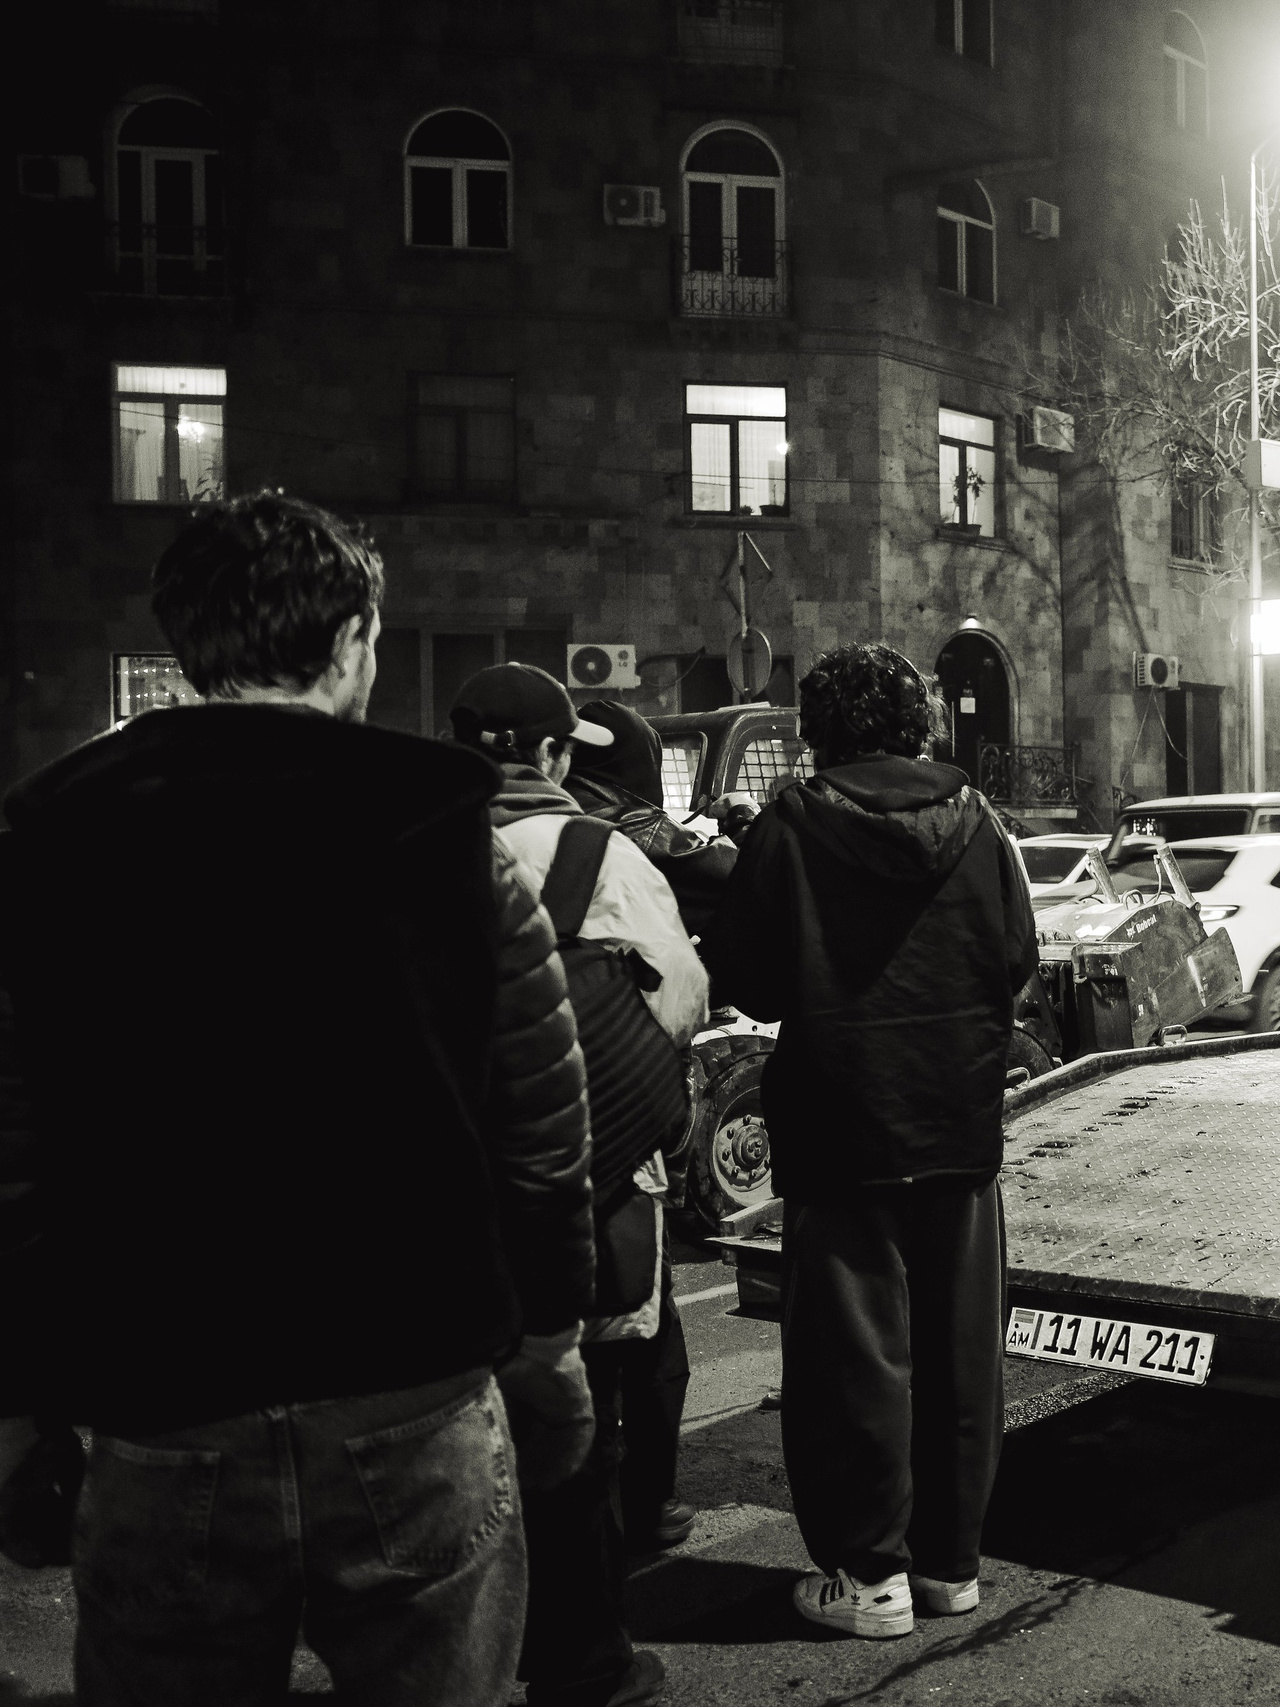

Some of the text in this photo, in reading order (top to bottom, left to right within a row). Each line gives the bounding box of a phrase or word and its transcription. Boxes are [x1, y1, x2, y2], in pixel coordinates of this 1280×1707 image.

[1008, 1331, 1030, 1348] AM
[1042, 1314, 1201, 1376] 11 WA 211
